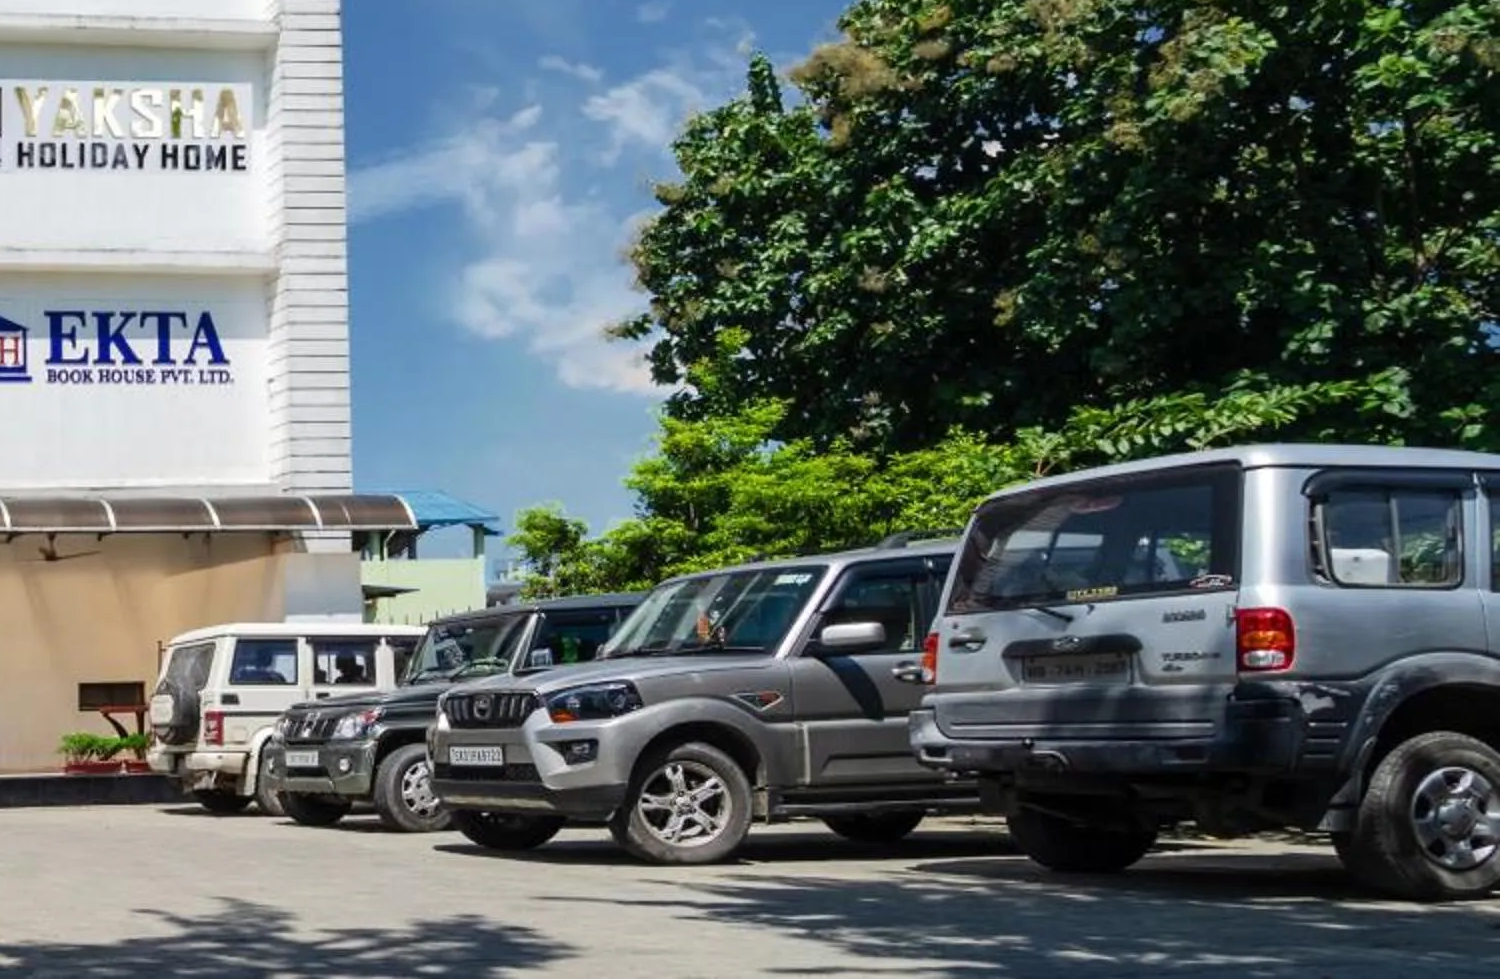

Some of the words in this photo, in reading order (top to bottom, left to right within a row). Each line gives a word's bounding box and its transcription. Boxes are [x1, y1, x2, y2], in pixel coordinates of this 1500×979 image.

[13, 86, 246, 140] YAKSHA
[17, 142, 150, 170] HOLIDAY
[161, 144, 248, 171] HOME
[43, 310, 231, 366] EKTA
[47, 370, 95, 384] BOOK
[99, 370, 156, 384] HOUSE
[160, 370, 194, 384] PVT.
[199, 370, 235, 384] LTD.
